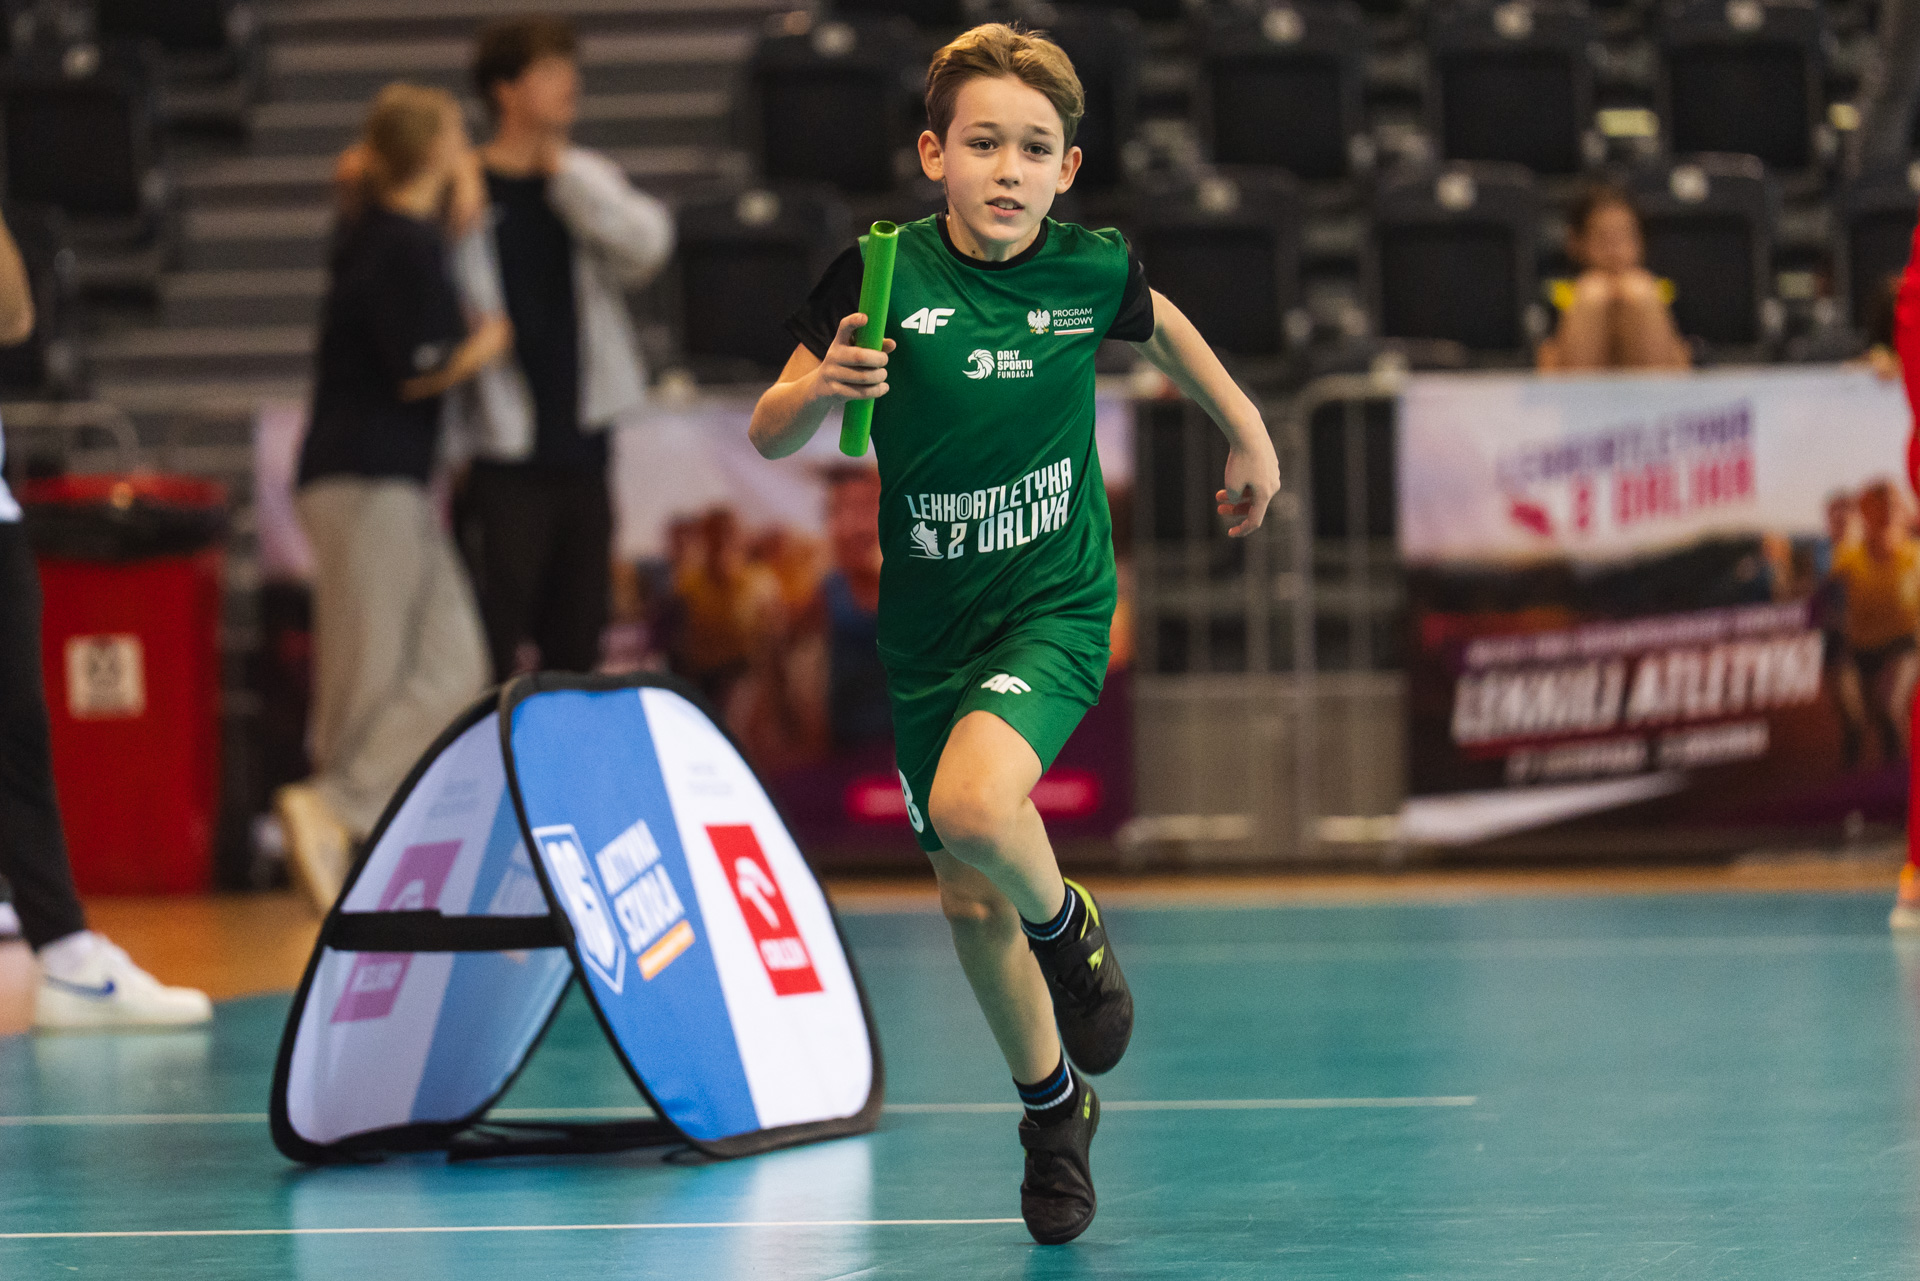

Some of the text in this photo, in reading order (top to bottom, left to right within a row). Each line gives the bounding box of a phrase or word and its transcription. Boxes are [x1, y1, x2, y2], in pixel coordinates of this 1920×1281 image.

[1052, 307, 1093, 318] PROGRAM
[901, 307, 956, 335] 4F
[1053, 316, 1094, 328] RZĄDOWY
[997, 350, 1020, 361] ORŁY
[997, 360, 1033, 371] SPORTU
[997, 370, 1034, 379] FUNDACJA
[904, 457, 1072, 522] LEKKOATLETYKA
[978, 490, 1070, 554] ORLIKA
[980, 673, 1032, 695] 4F
